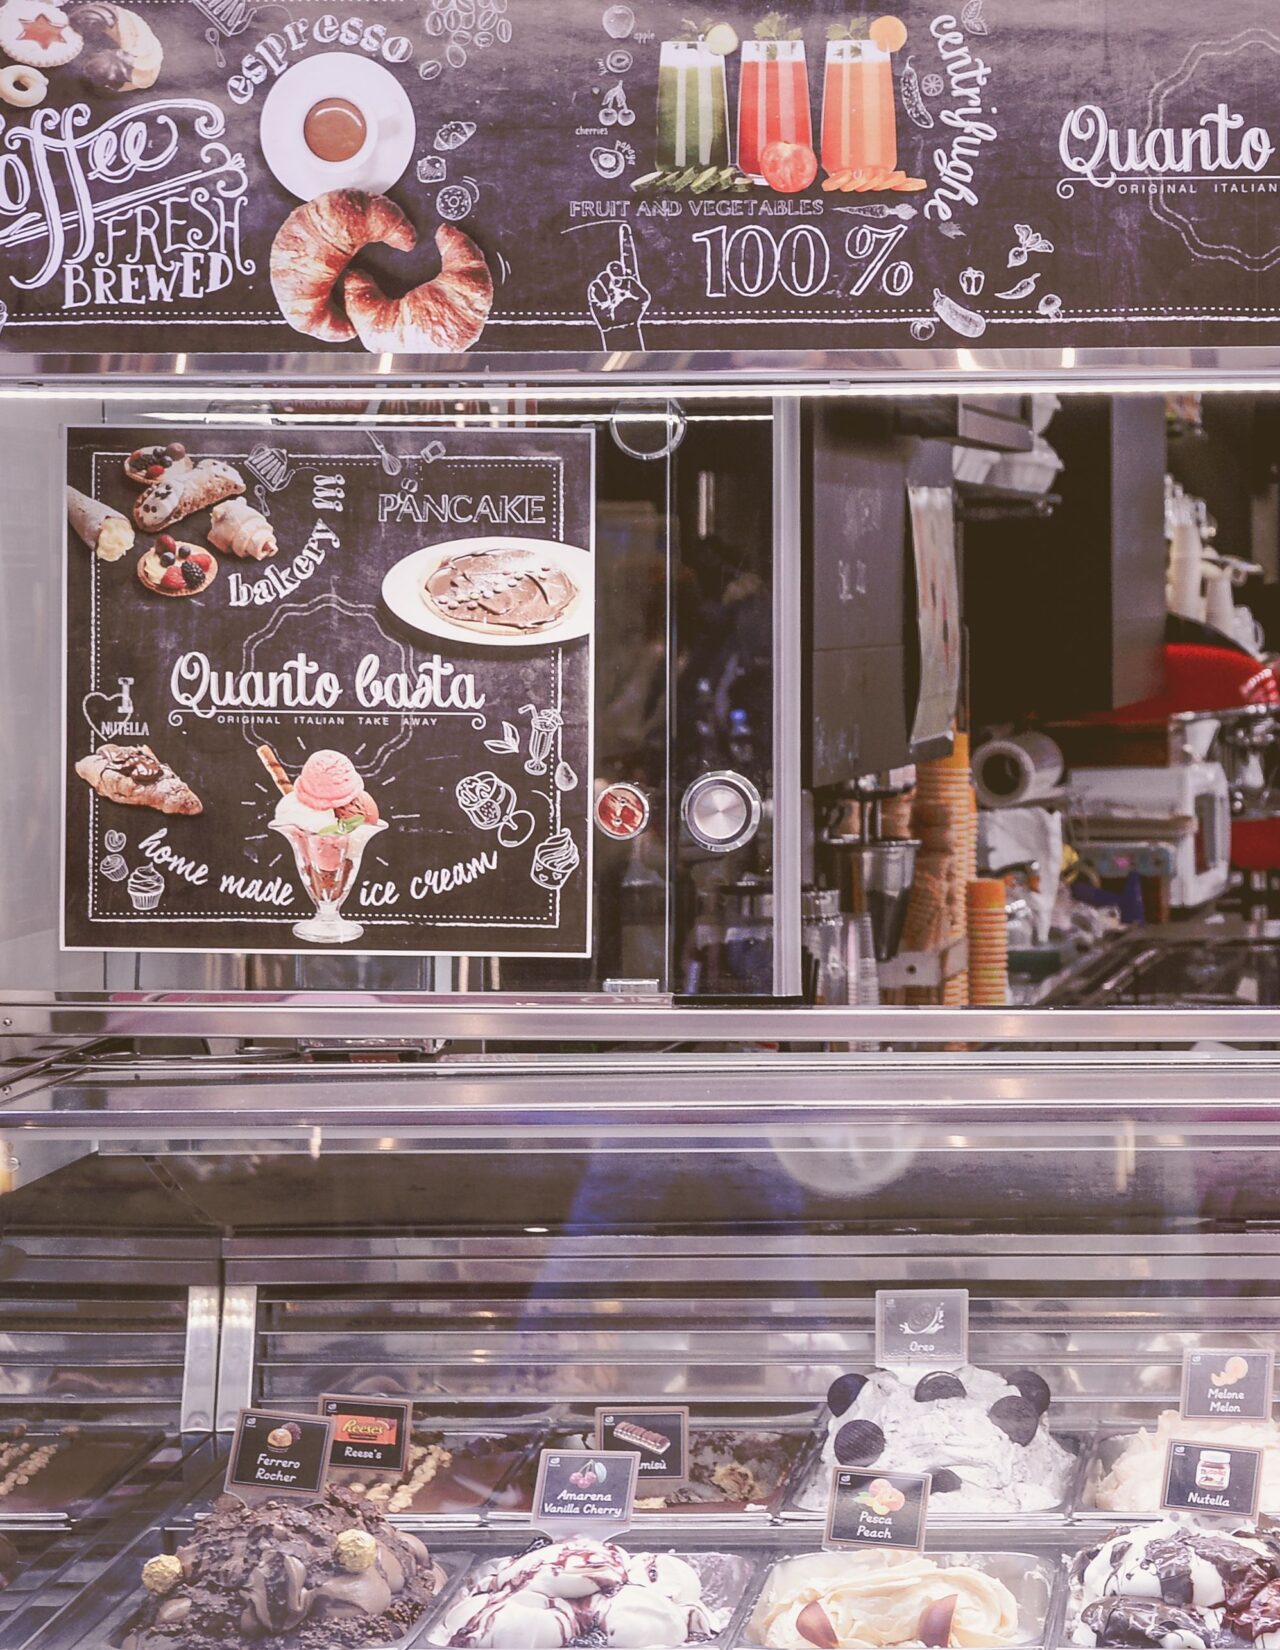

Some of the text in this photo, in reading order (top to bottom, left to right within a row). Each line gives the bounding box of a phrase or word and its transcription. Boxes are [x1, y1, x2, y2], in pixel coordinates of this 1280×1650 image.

[633, 30, 656, 44] apple
[227, 14, 414, 105] espresso
[924, 14, 998, 222] centrifughe
[575, 126, 608, 136] cherries
[615, 140, 636, 166] papaya
[1059, 103, 1275, 188] Quanto
[0, 98, 226, 289] offee
[1118, 183, 1198, 195] ORIGINAL
[1214, 182, 1278, 194] ITALIAN
[570, 199, 824, 218] FRUIT AND VEGETABLES
[95, 187, 256, 276] FRESH
[692, 224, 914, 298] 100 %
[62, 251, 233, 310] BREWED
[378, 493, 546, 524] PANCAKE
[227, 518, 341, 607] bakery
[170, 651, 486, 718] Quanto basta
[217, 714, 438, 727] ORIGINAL ITALIAN TAKE AWAY
[101, 721, 150, 737] NUTELLA
[138, 827, 498, 907] home made ice cream
[909, 1341, 935, 1352] Oreo
[1208, 1388, 1245, 1400] Melone
[1210, 1402, 1241, 1413] Melon
[256, 1453, 301, 1469] Ferrero
[344, 1446, 382, 1460] Reese's
[638, 1459, 667, 1470] misù
[255, 1467, 297, 1483] Rocher
[557, 1489, 613, 1502] Amarena
[1187, 1492, 1231, 1507] Nutella
[543, 1503, 622, 1517] Vanilla Cherry
[859, 1511, 893, 1525] Pesca
[857, 1525, 892, 1539] Peach
